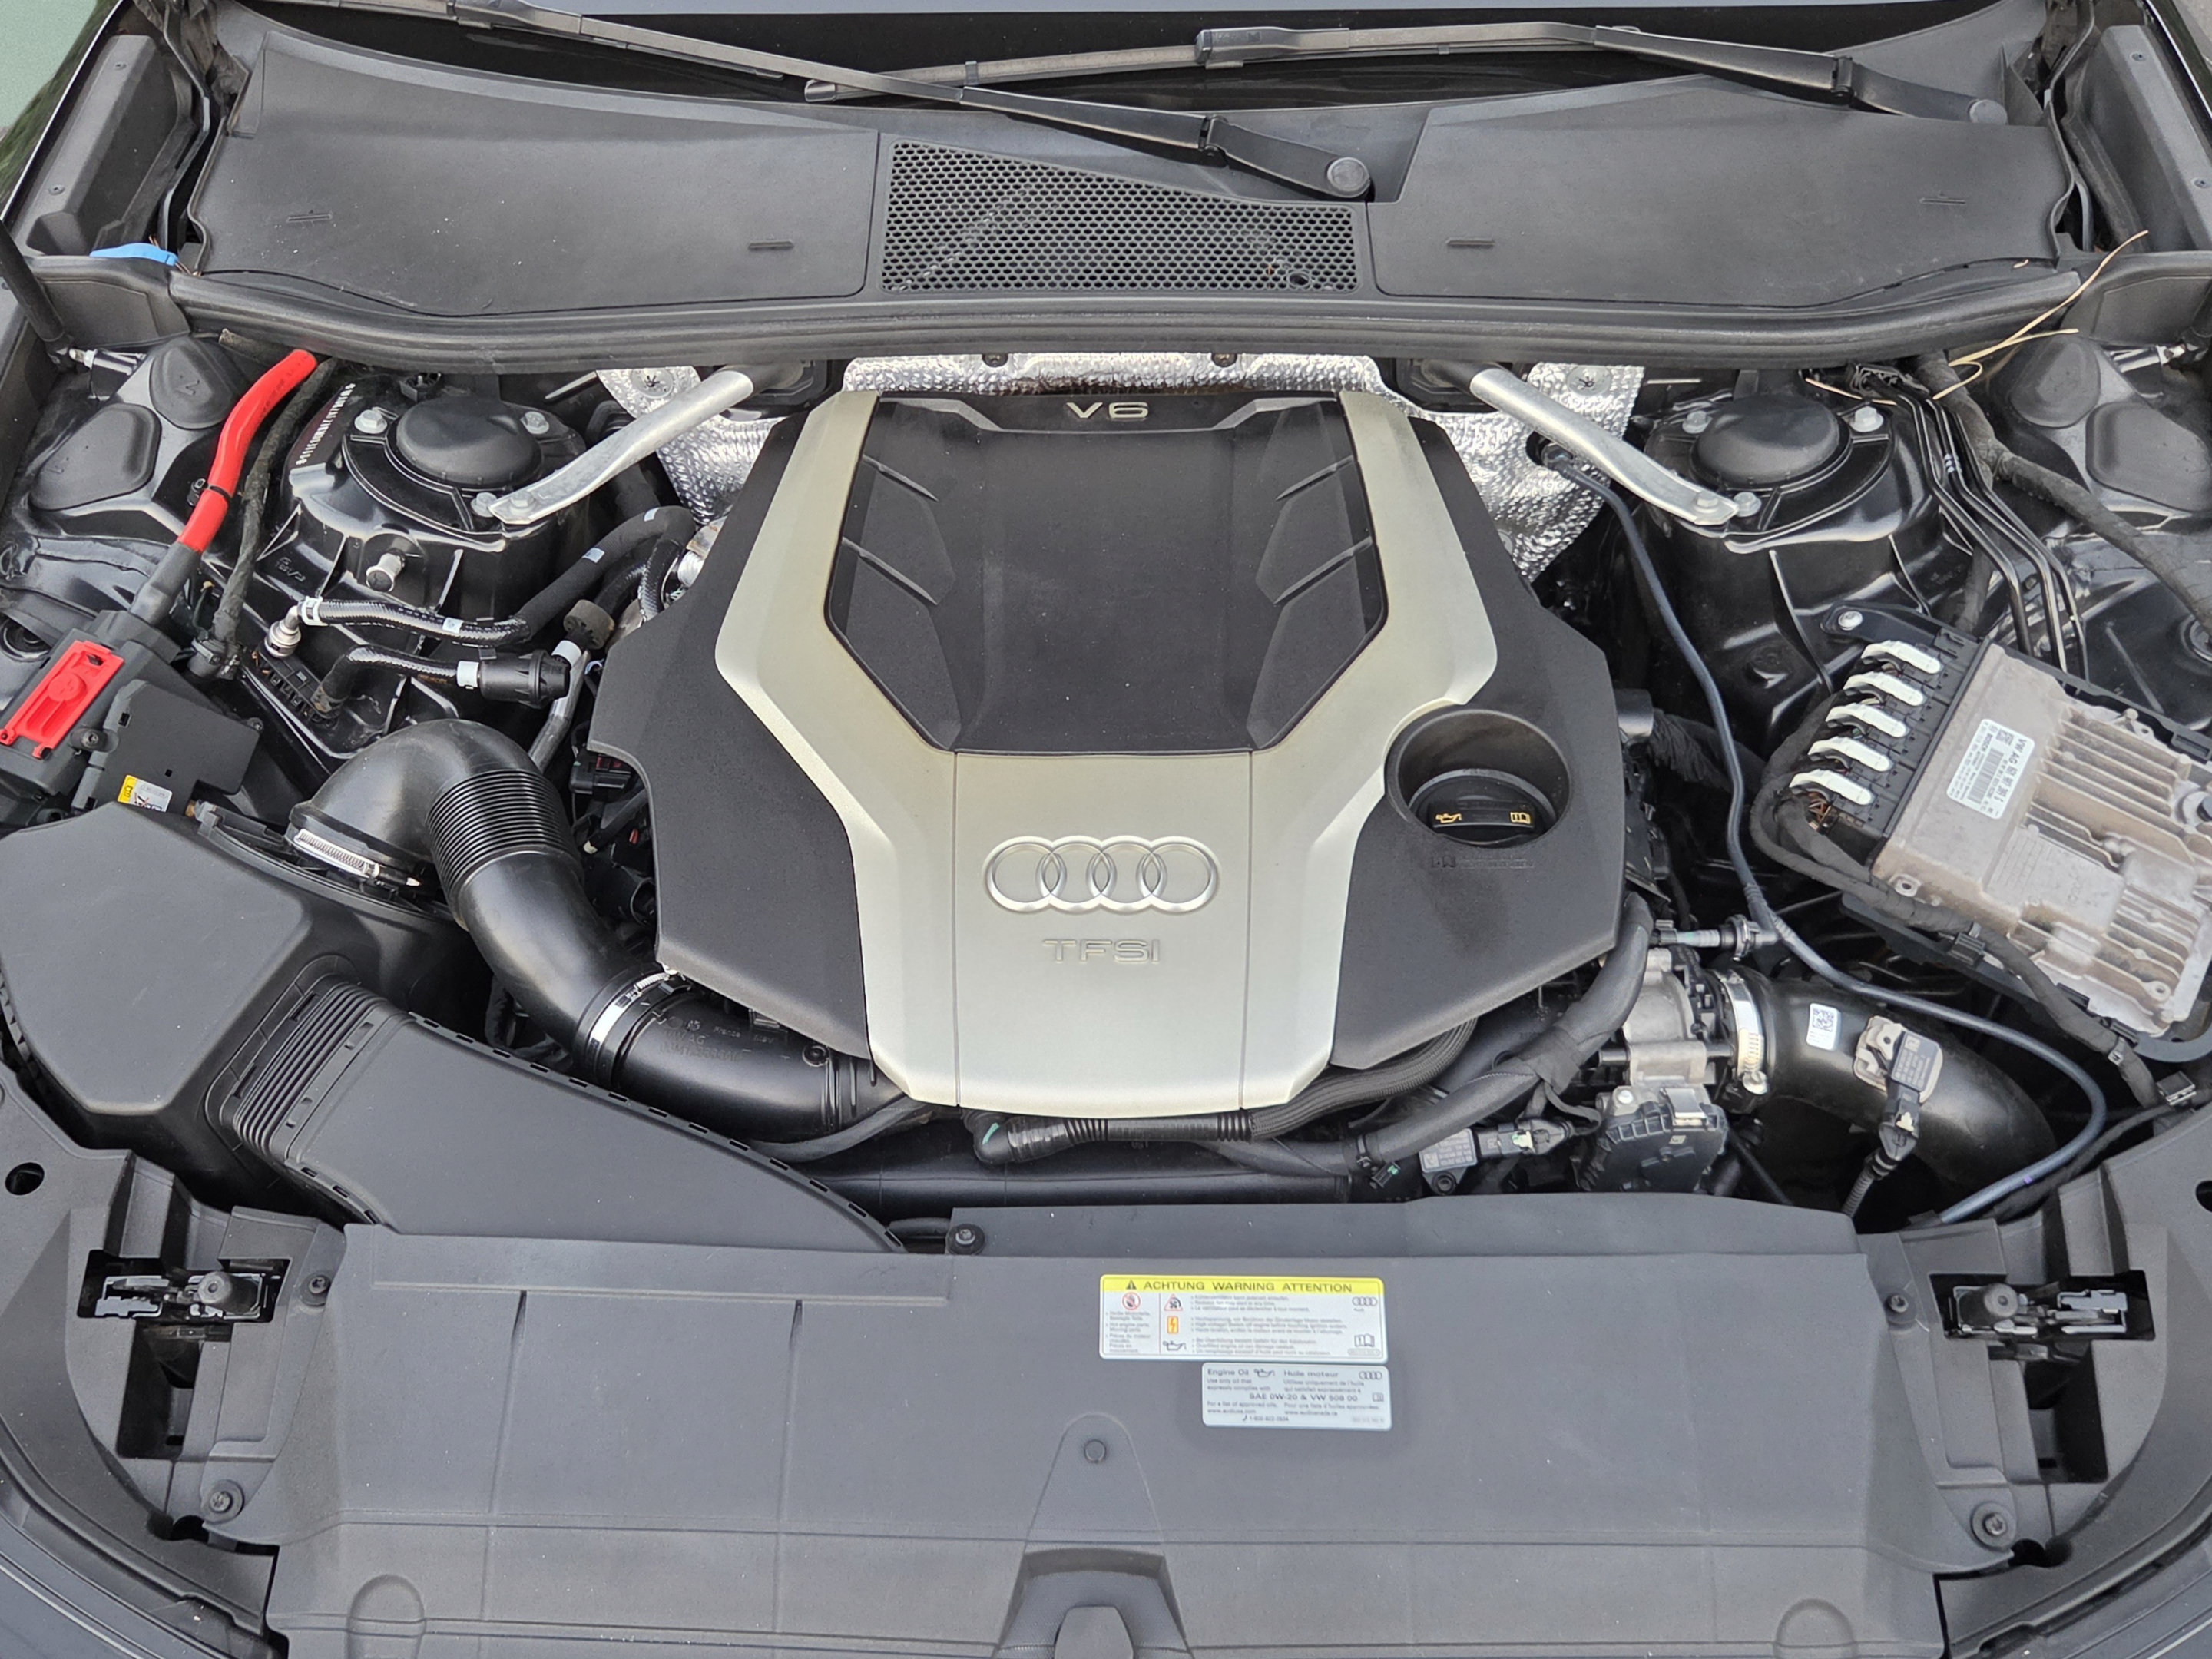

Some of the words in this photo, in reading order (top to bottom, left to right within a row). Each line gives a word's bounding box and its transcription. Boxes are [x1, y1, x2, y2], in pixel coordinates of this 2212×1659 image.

[1066, 402, 1148, 419] V6
[2014, 738, 2028, 753] VW
[2008, 752, 2021, 765] AG
[1042, 939, 1161, 964] TFSI
[1144, 1281, 1205, 1291] ACHTUNG
[1212, 1282, 1275, 1291] WARNING
[1282, 1283, 1353, 1293] ATTENTION
